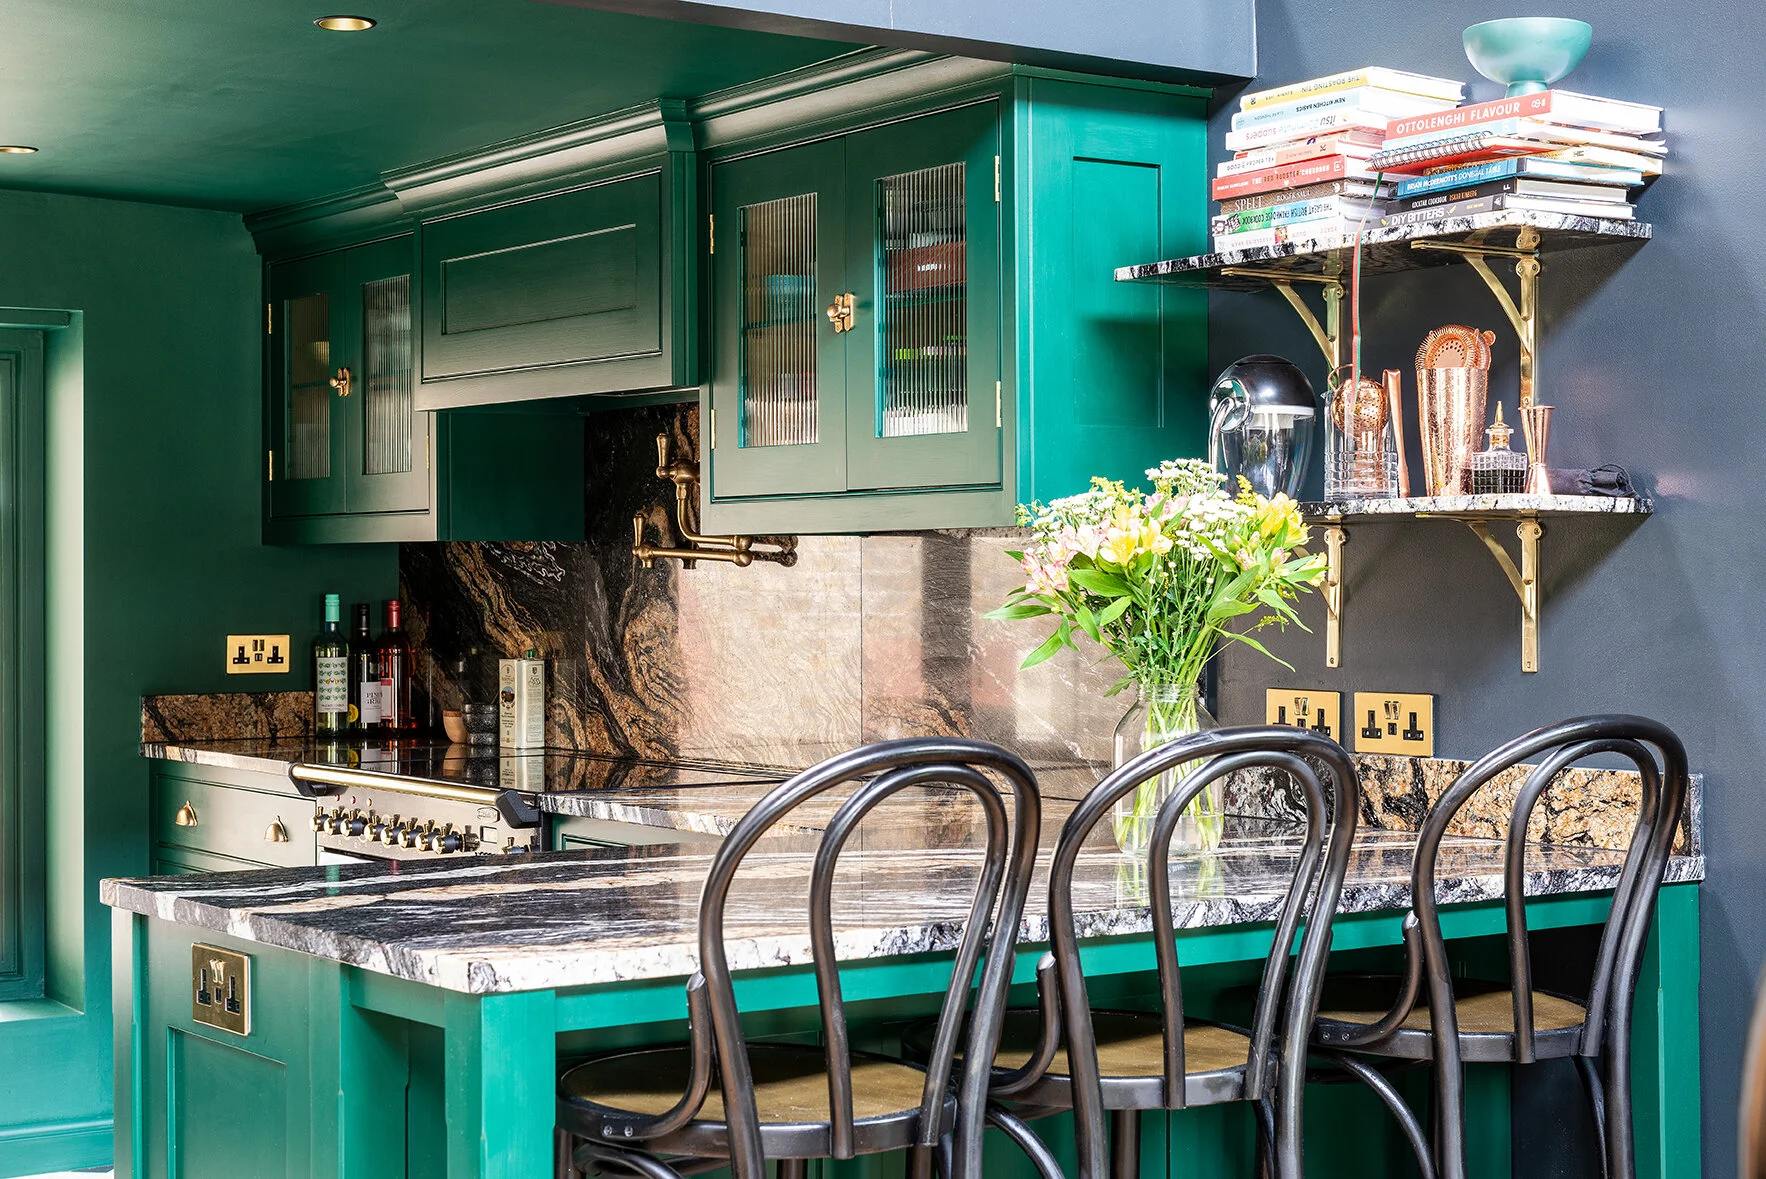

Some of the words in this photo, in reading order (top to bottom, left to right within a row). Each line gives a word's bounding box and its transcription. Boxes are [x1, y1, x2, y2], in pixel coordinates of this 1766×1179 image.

[1313, 77, 1346, 90] ROASTING
[1348, 75, 1360, 83] THE
[1301, 85, 1312, 93] TIN
[1295, 104, 1313, 112] BASICS
[1312, 100, 1334, 109] KITCHEN
[1320, 115, 1337, 127] itsu
[1396, 112, 1466, 135] OTTOLENGHI
[1470, 102, 1520, 121] FLAVOUR
[1245, 127, 1277, 141] suppers
[1252, 177, 1263, 185] THE
[1263, 175, 1274, 183] RED
[1275, 170, 1301, 181] ROOSTER
[1406, 180, 1423, 191] BRIAN
[1458, 168, 1485, 181] DONEGAL
[1485, 164, 1502, 176] TABLE
[1234, 195, 1264, 212] SPELT
[1322, 203, 1332, 212] THE
[1411, 200, 1428, 209] COCKTAIL
[1428, 195, 1447, 206] COOKBOOK
[1289, 206, 1308, 218] BRITISH
[1308, 204, 1323, 215] GREAT
[1241, 212, 1265, 225] COOKBOOK
[1391, 213, 1406, 226] DIY
[1407, 208, 1445, 223] BITTERS
